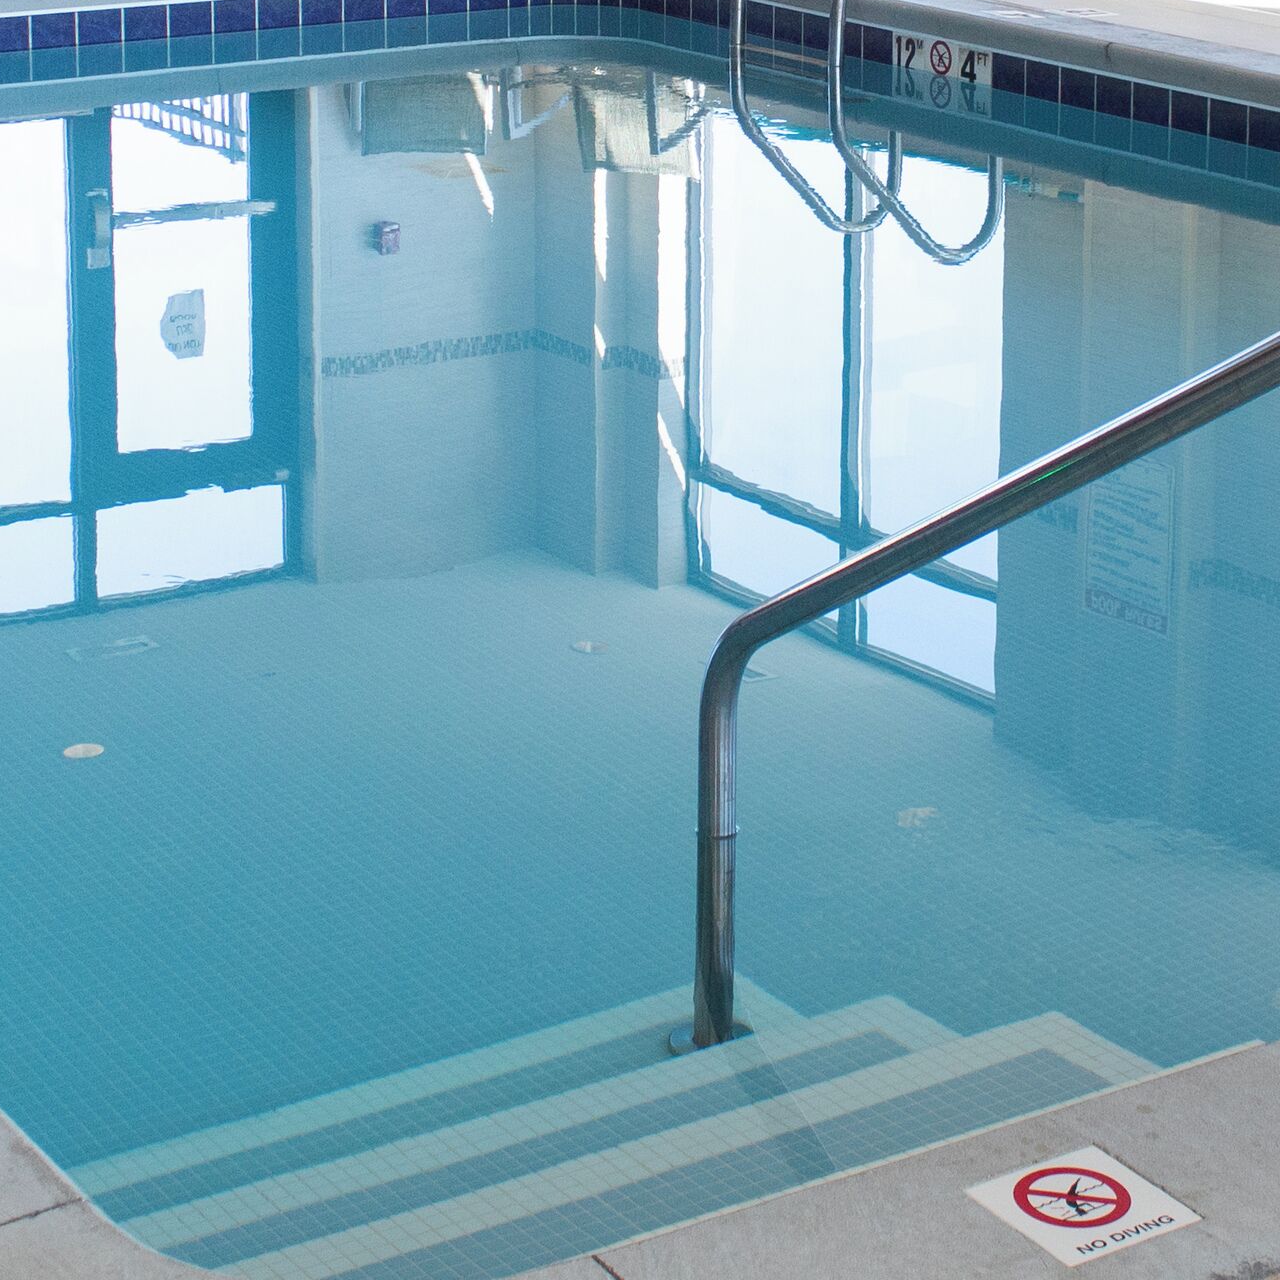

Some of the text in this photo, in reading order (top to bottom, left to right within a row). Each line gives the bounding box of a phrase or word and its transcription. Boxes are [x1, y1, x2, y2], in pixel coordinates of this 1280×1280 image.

[961, 50, 976, 83] 4
[977, 52, 989, 66] FT
[1076, 1214, 1176, 1255] NO DIVING
